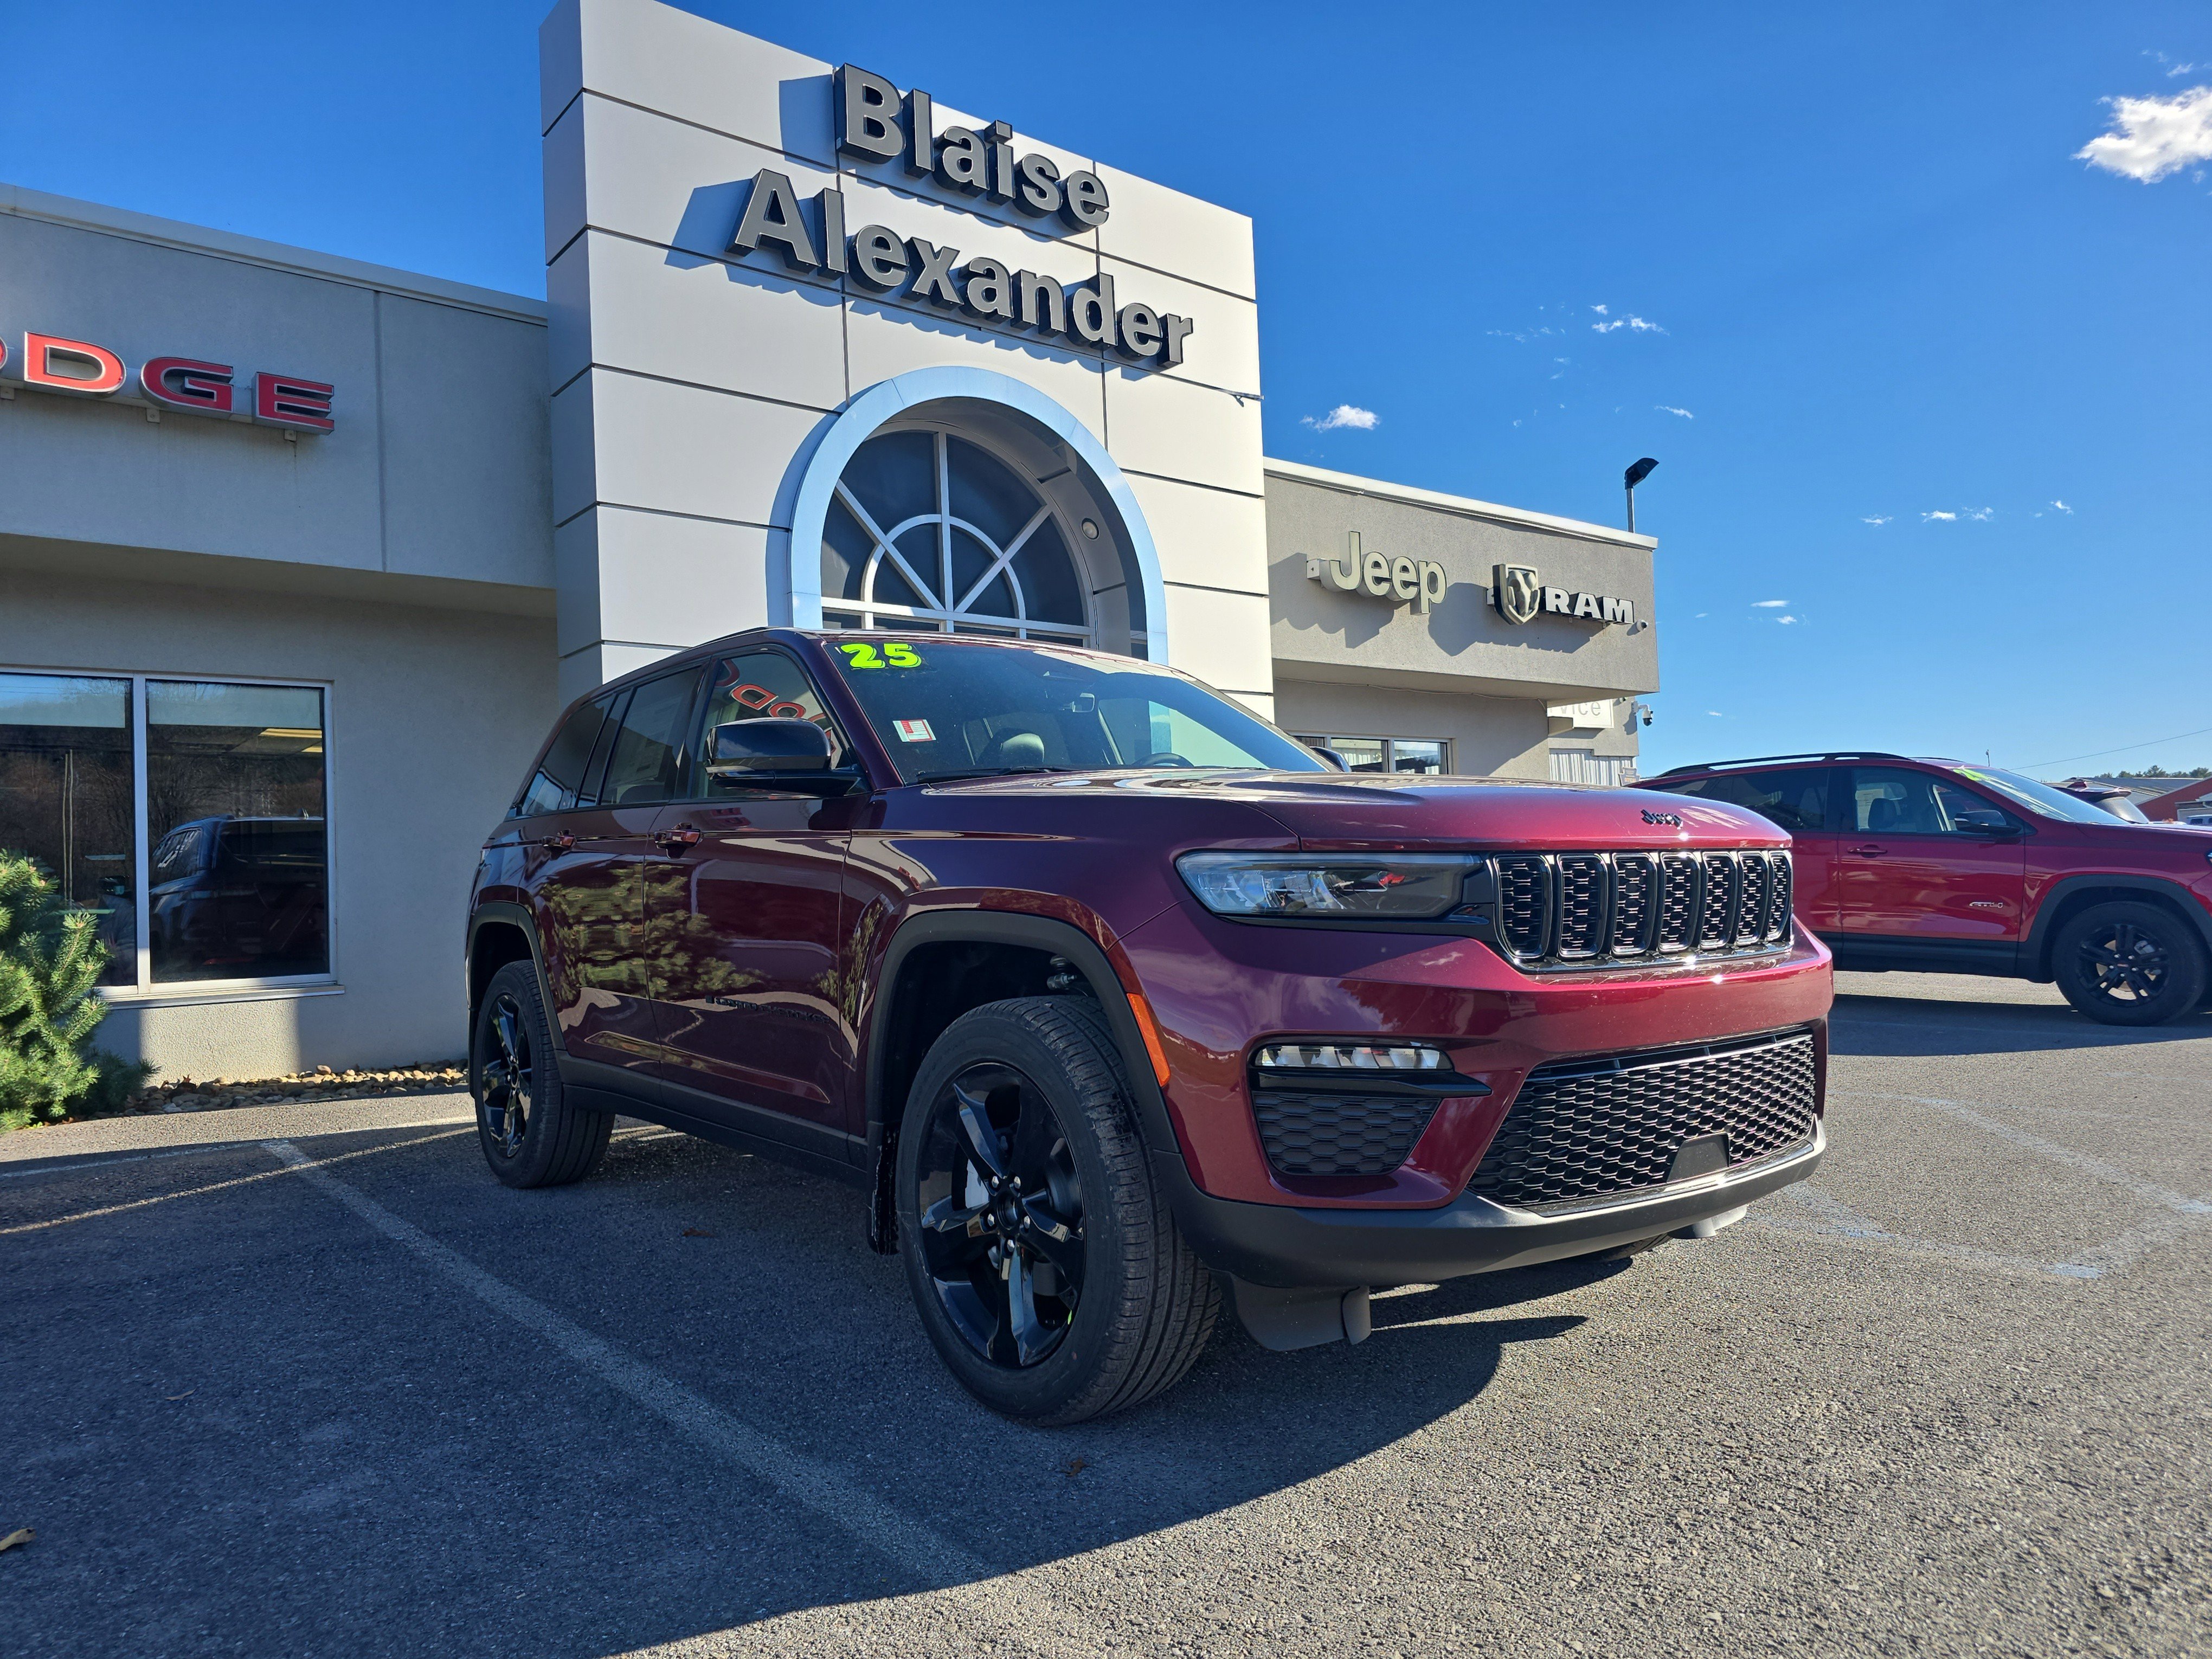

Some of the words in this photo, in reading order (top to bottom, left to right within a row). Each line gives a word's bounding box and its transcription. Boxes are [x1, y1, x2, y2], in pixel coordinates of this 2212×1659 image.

[834, 63, 1110, 232] Blaise
[726, 168, 1193, 369] Alexander
[0, 331, 335, 435] DGE
[1324, 530, 1446, 614] Jeep
[1541, 586, 1634, 624] RAM
[1641, 809, 1683, 829] Jeep
